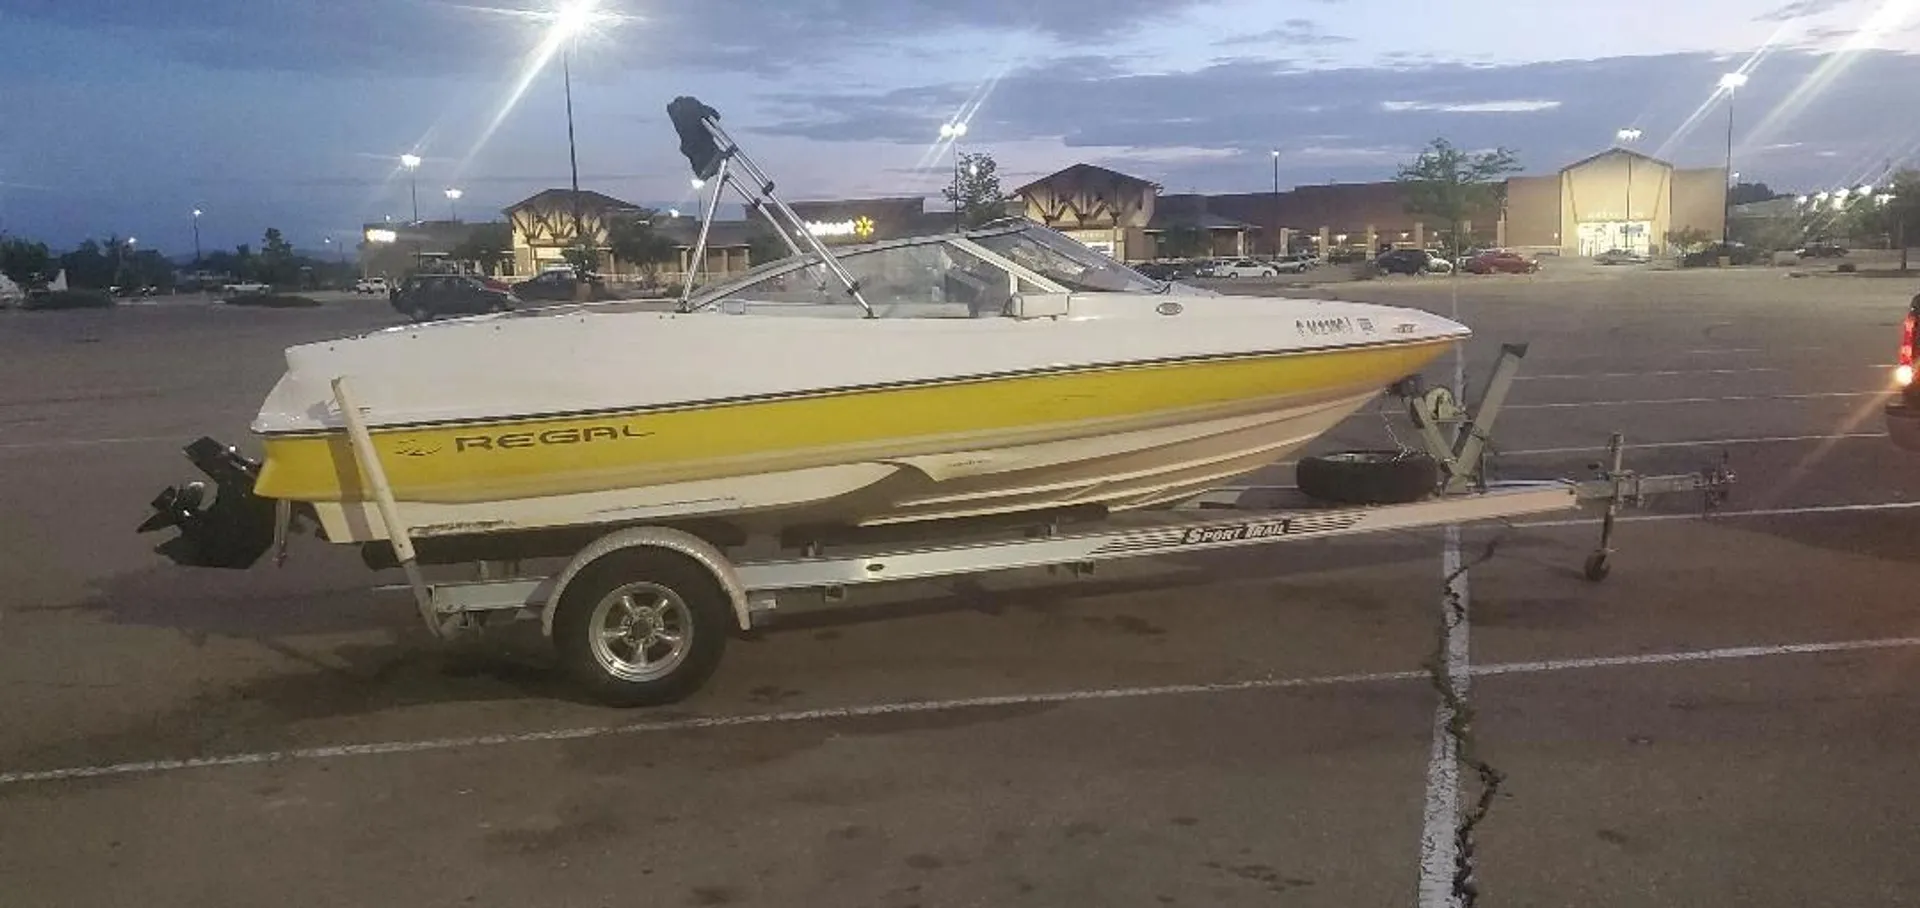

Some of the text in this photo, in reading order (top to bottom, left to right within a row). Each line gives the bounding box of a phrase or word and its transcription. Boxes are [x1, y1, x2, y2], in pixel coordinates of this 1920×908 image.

[455, 425, 656, 452] REGAL
[1186, 521, 1285, 543] SPORT TRAIL
